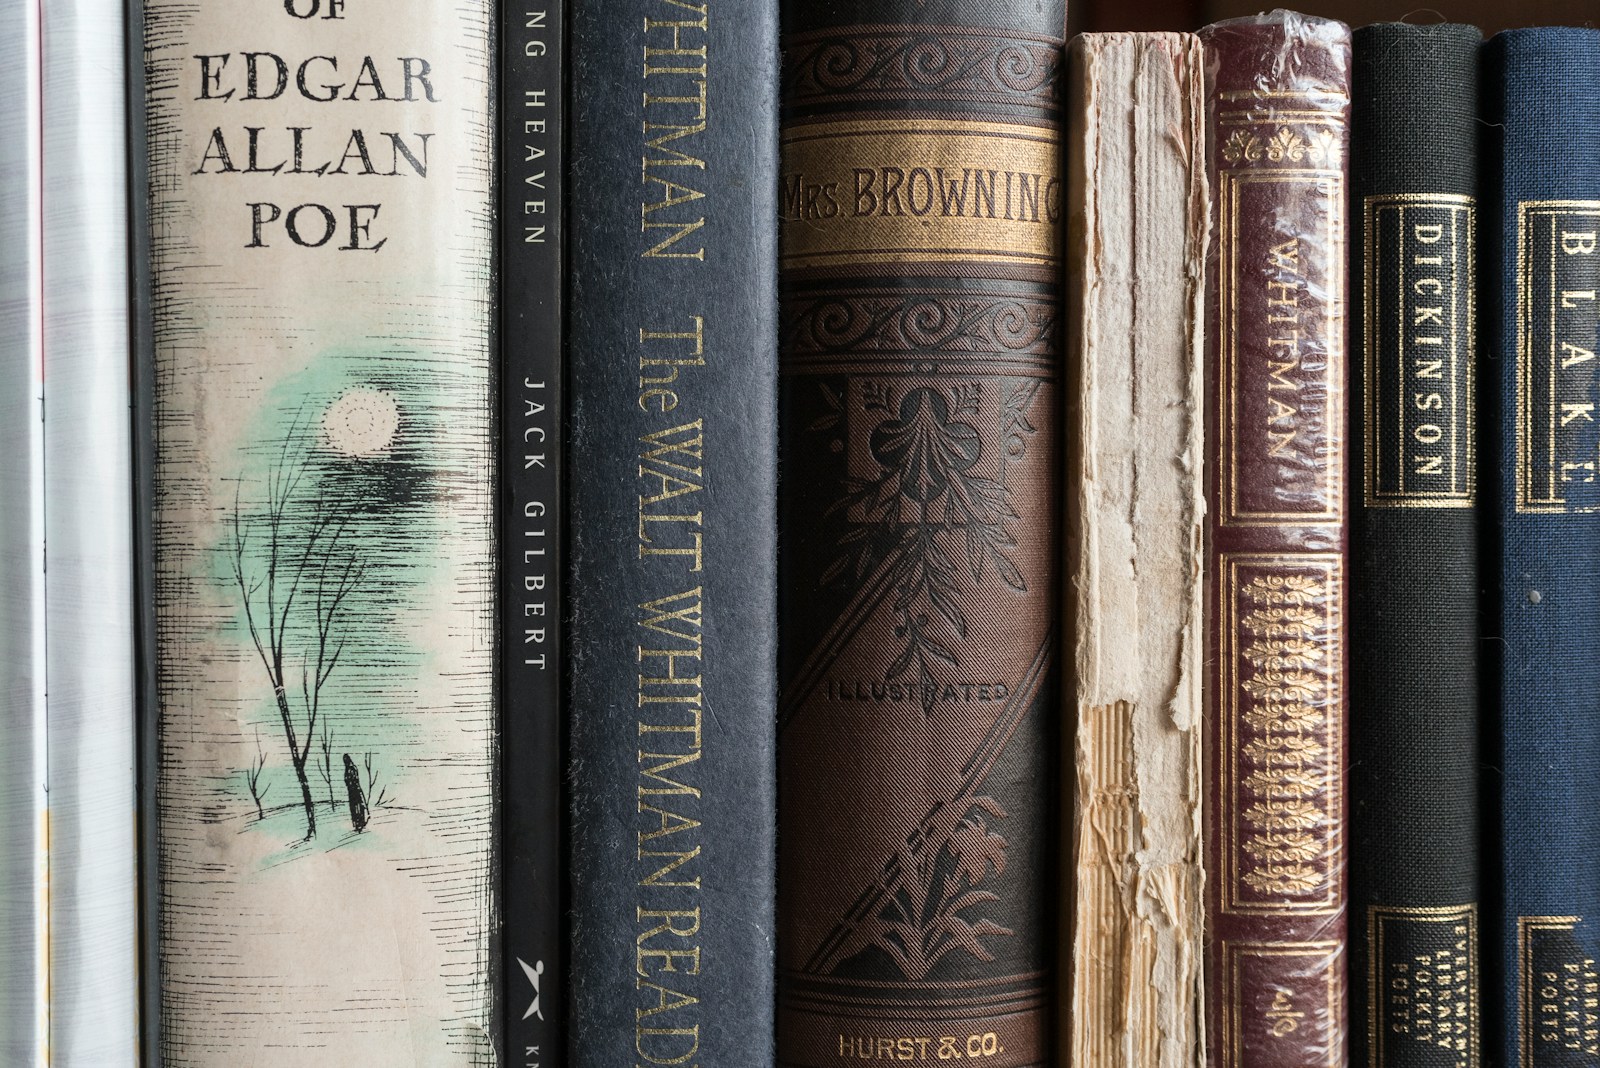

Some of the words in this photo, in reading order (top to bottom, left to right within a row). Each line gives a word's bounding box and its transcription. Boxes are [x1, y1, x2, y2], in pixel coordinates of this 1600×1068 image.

[192, 51, 441, 103] EDGAR
[525, 10, 546, 58] NG
[190, 126, 436, 179] ALLAN
[525, 89, 546, 243] HEAVEN
[641, 0, 708, 262] HITMAN
[244, 202, 388, 254] POE
[638, 313, 706, 413] The
[1266, 237, 1299, 458] WHITMAN
[1413, 223, 1444, 478] DICKINSON
[1561, 230, 1597, 483] BLAKE
[524, 376, 546, 470] JACK
[637, 417, 704, 573] WALT
[524, 500, 546, 670] GILBERT
[637, 585, 704, 890] WHITMAN
[826, 681, 1009, 702] ILLUSTRATED
[635, 905, 701, 1068] READ
[1391, 963, 1410, 1034] POETS
[1415, 954, 1432, 1043] POCKET
[1437, 950, 1452, 1048] LIBRARY
[1541, 971, 1559, 1042] POETS
[1564, 963, 1581, 1050] POCKET
[1583, 958, 1599, 1054] LIBRARY
[839, 1034, 932, 1061] HURST
[937, 1036, 963, 1061] &
[966, 1031, 1004, 1059] CO.
